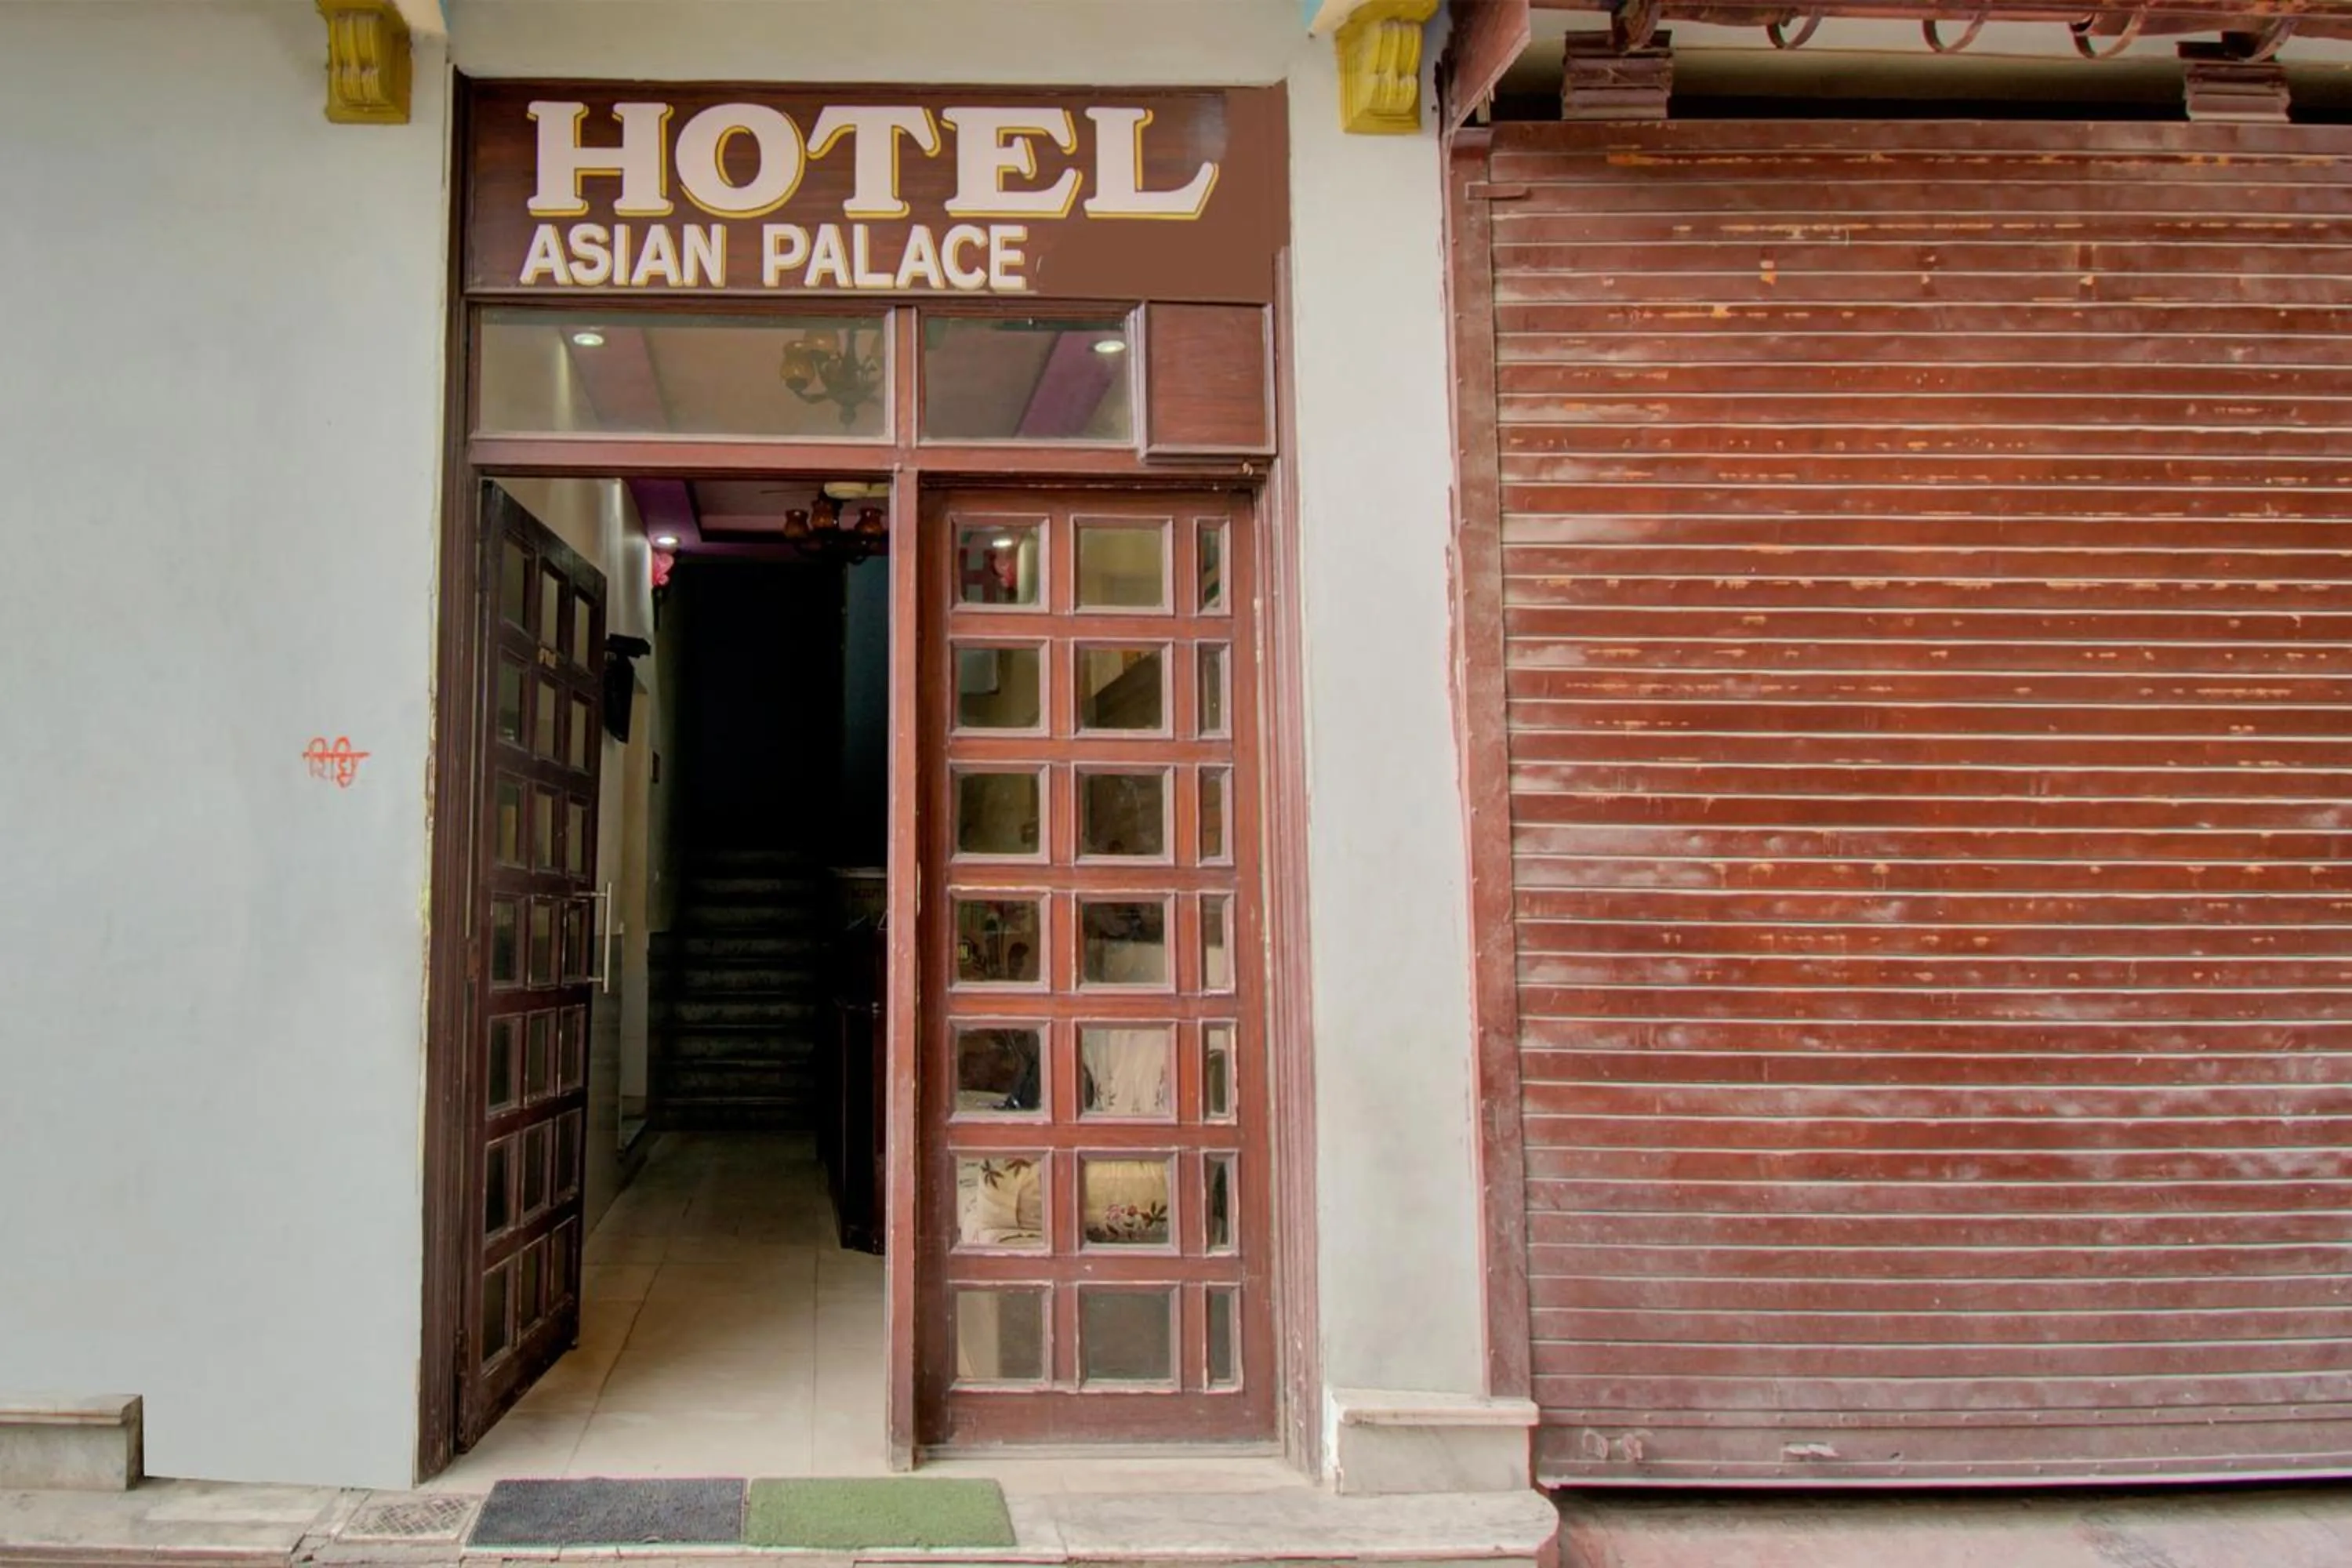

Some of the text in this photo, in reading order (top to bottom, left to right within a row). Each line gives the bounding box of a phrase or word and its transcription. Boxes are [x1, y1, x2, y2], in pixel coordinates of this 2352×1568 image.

[527, 101, 1219, 220] HOTEL
[519, 223, 1028, 290] ASIAN PALACE
